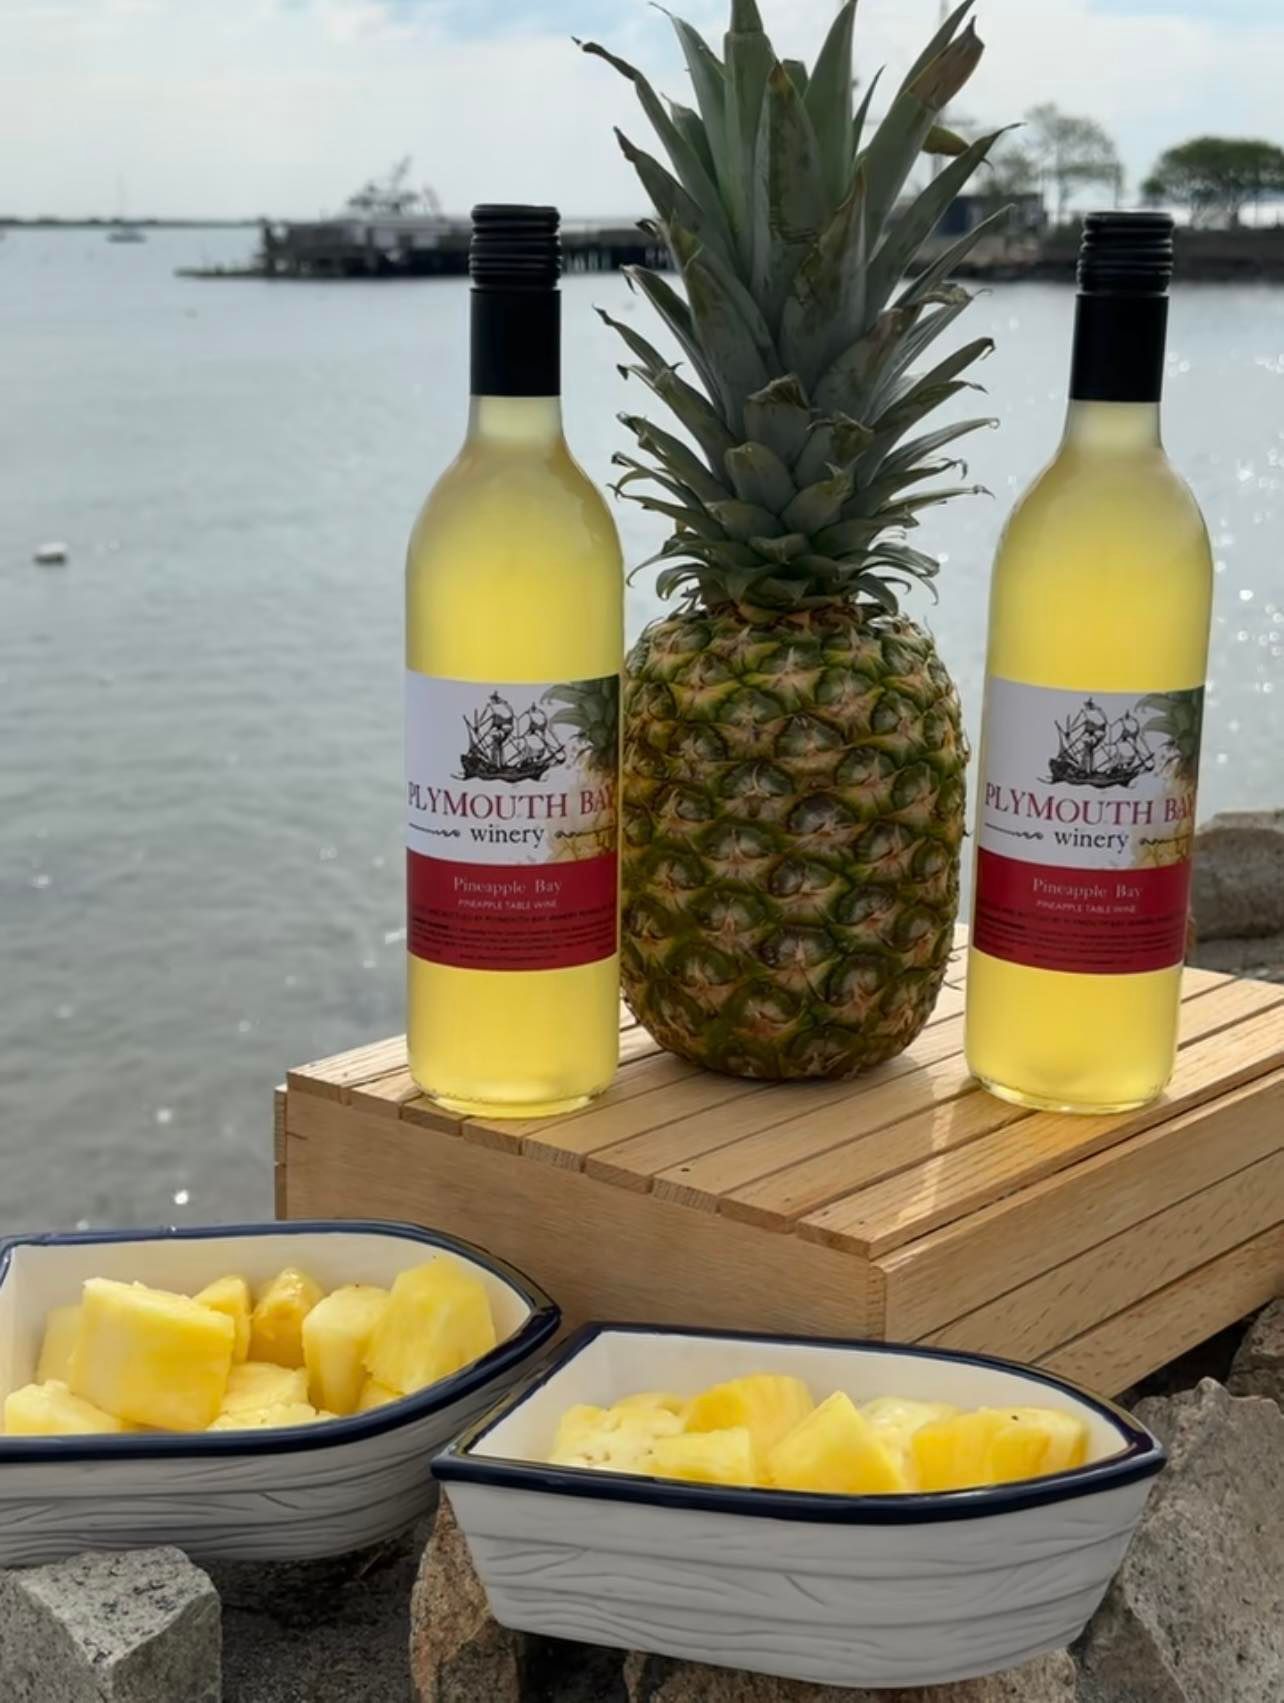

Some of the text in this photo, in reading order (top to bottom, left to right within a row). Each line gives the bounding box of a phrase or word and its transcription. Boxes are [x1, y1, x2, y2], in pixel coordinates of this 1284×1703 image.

[408, 781, 567, 819] PLYMOUTH
[985, 782, 1153, 825] PLYMOUTH
[470, 824, 545, 847] winery
[1054, 828, 1129, 854] winery
[453, 876, 562, 896] Pineapple Bay
[1032, 877, 1144, 900] Pineapple Bay
[458, 899, 503, 910] PINEAPPLE
[504, 900, 530, 910] TABLE
[1036, 900, 1083, 913] PINEAPPLE
[1085, 903, 1110, 914] TABLE
